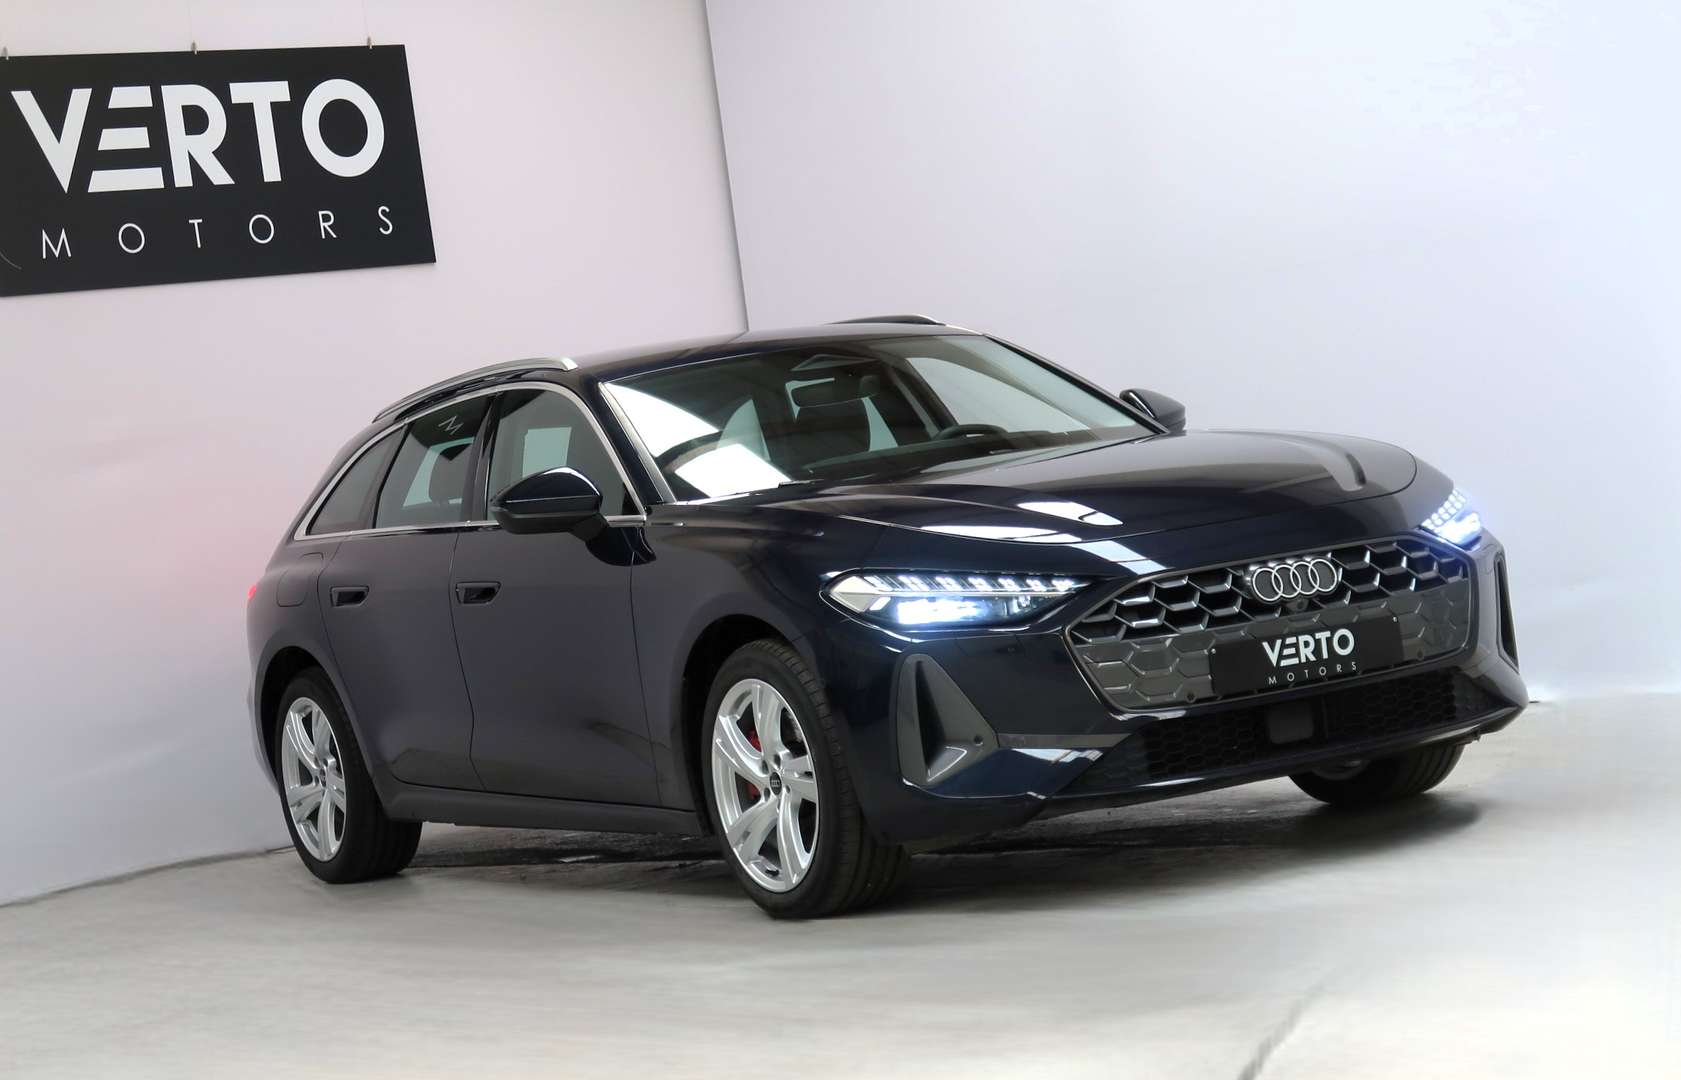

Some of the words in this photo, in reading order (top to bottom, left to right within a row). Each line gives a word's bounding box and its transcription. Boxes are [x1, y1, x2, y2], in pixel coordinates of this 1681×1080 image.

[11, 79, 385, 194] VERTO
[41, 206, 394, 260] MOTORS
[1262, 628, 1355, 668] VERTO
[1268, 661, 1357, 686] MOTORS
